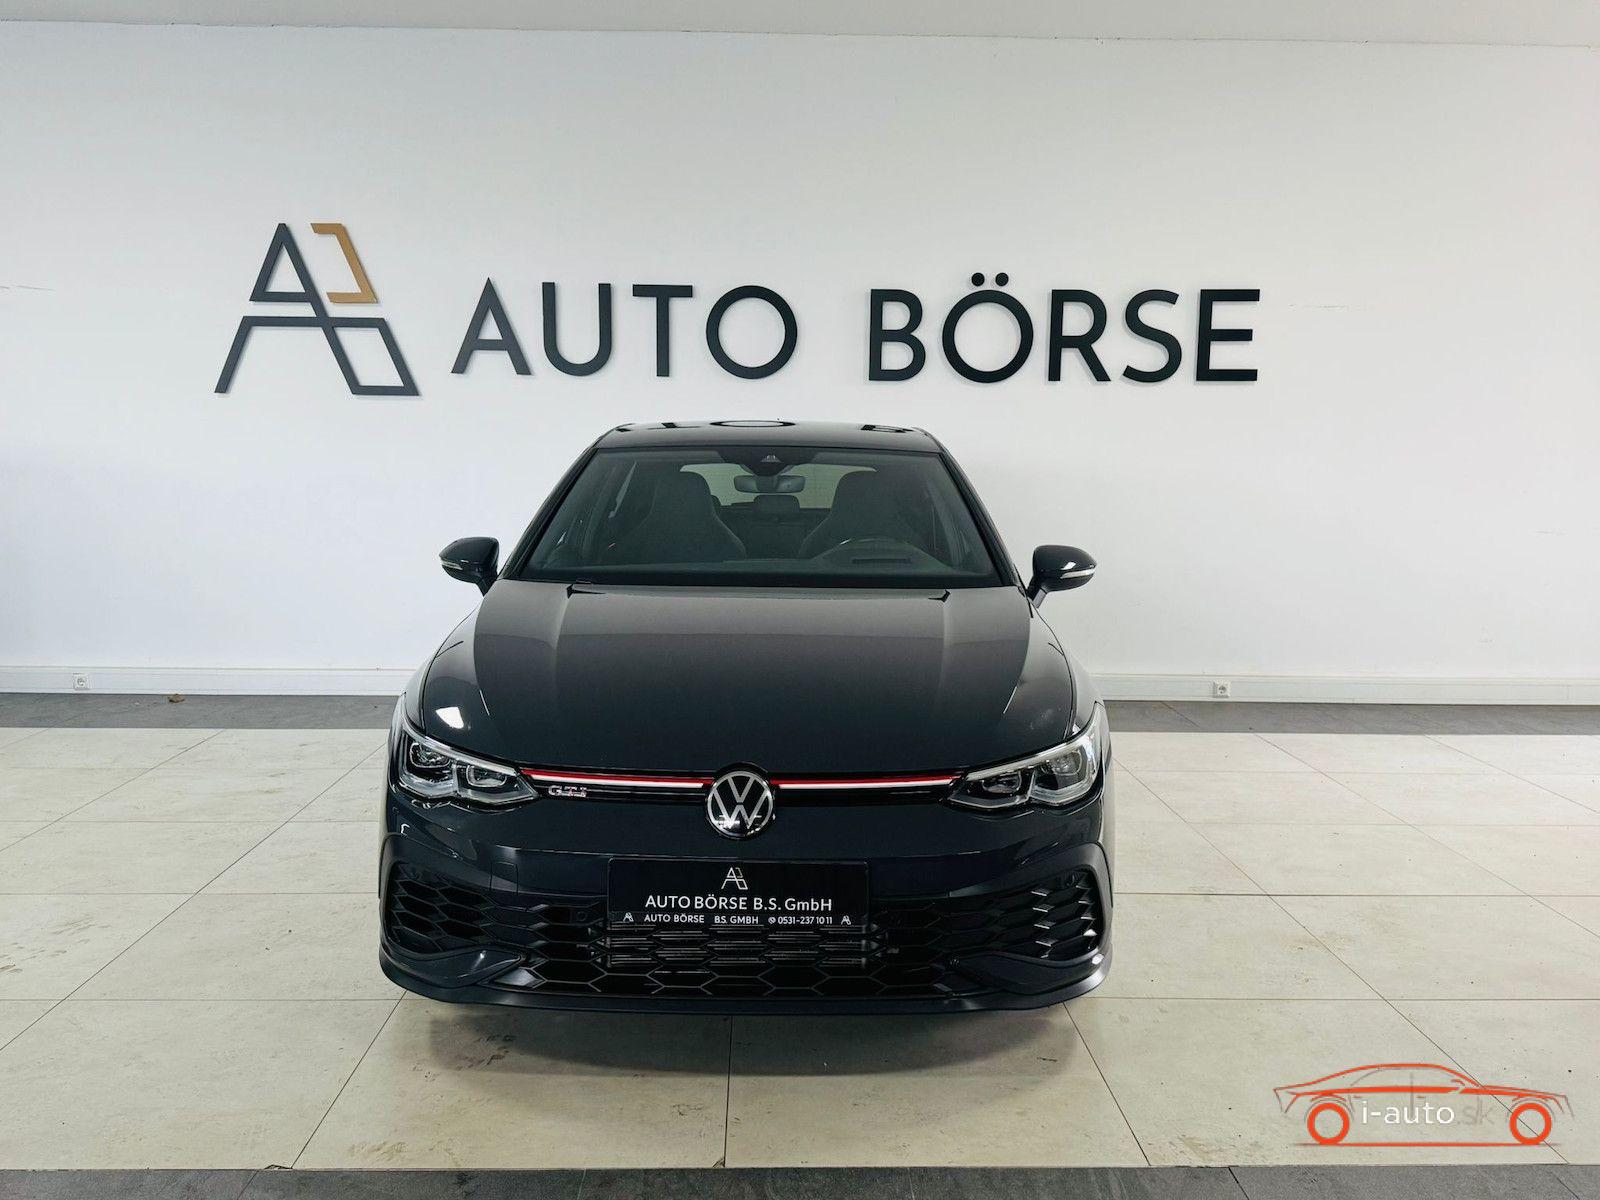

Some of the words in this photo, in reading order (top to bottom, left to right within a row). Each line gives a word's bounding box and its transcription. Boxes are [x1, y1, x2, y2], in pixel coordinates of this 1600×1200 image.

[451, 277, 798, 379] AUTO
[868, 272, 1261, 384] BÖRSE
[548, 784, 588, 798] GTI
[645, 894, 691, 909] AUTO
[694, 893, 748, 910] BÖRSE
[753, 896, 782, 911] B.S.
[784, 897, 832, 912] GmbH
[644, 914, 671, 923] AUTO
[673, 913, 705, 923] BÖRSE
[730, 915, 759, 925] GMBH
